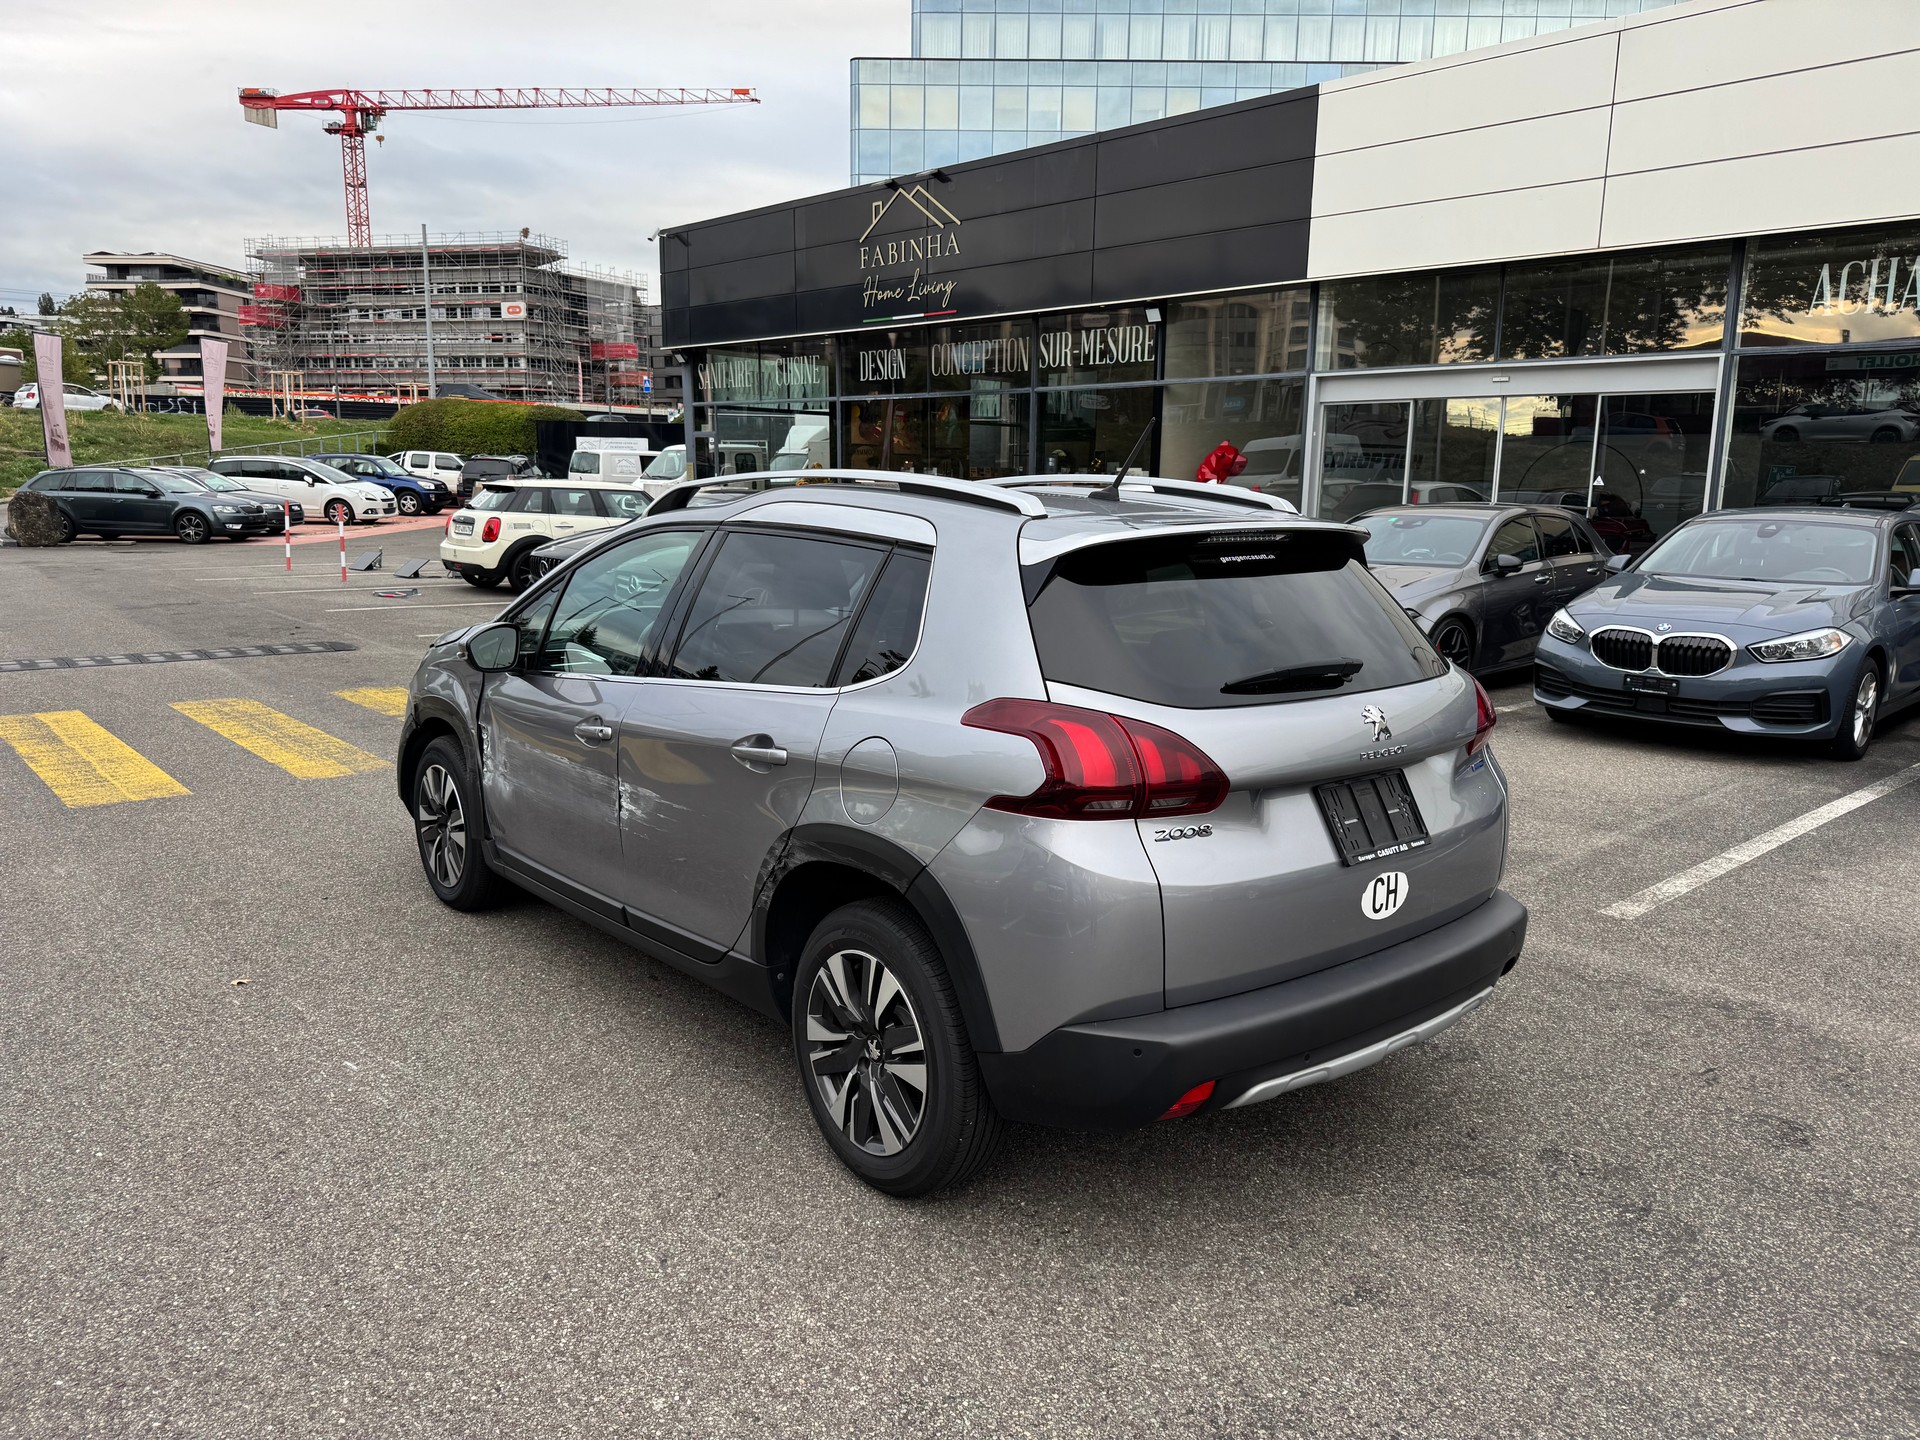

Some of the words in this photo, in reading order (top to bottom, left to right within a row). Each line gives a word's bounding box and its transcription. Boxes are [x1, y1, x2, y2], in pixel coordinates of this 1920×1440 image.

[860, 231, 960, 269] FABINHA
[863, 275, 904, 308] Home
[907, 268, 957, 308] Living
[1805, 255, 1920, 317] ACHA
[697, 359, 752, 390] SANITAIRE
[775, 354, 821, 387] CUISINE
[859, 348, 907, 382] DESIGN
[931, 336, 1030, 377] CONCEPTION
[1039, 324, 1157, 369] SUR-MESURE
[1360, 744, 1408, 760] PEUGEOT
[1154, 823, 1213, 842] 2008
[1377, 845, 1400, 858] CASUTT
[1400, 843, 1409, 852] AG
[1372, 872, 1399, 914] CH
